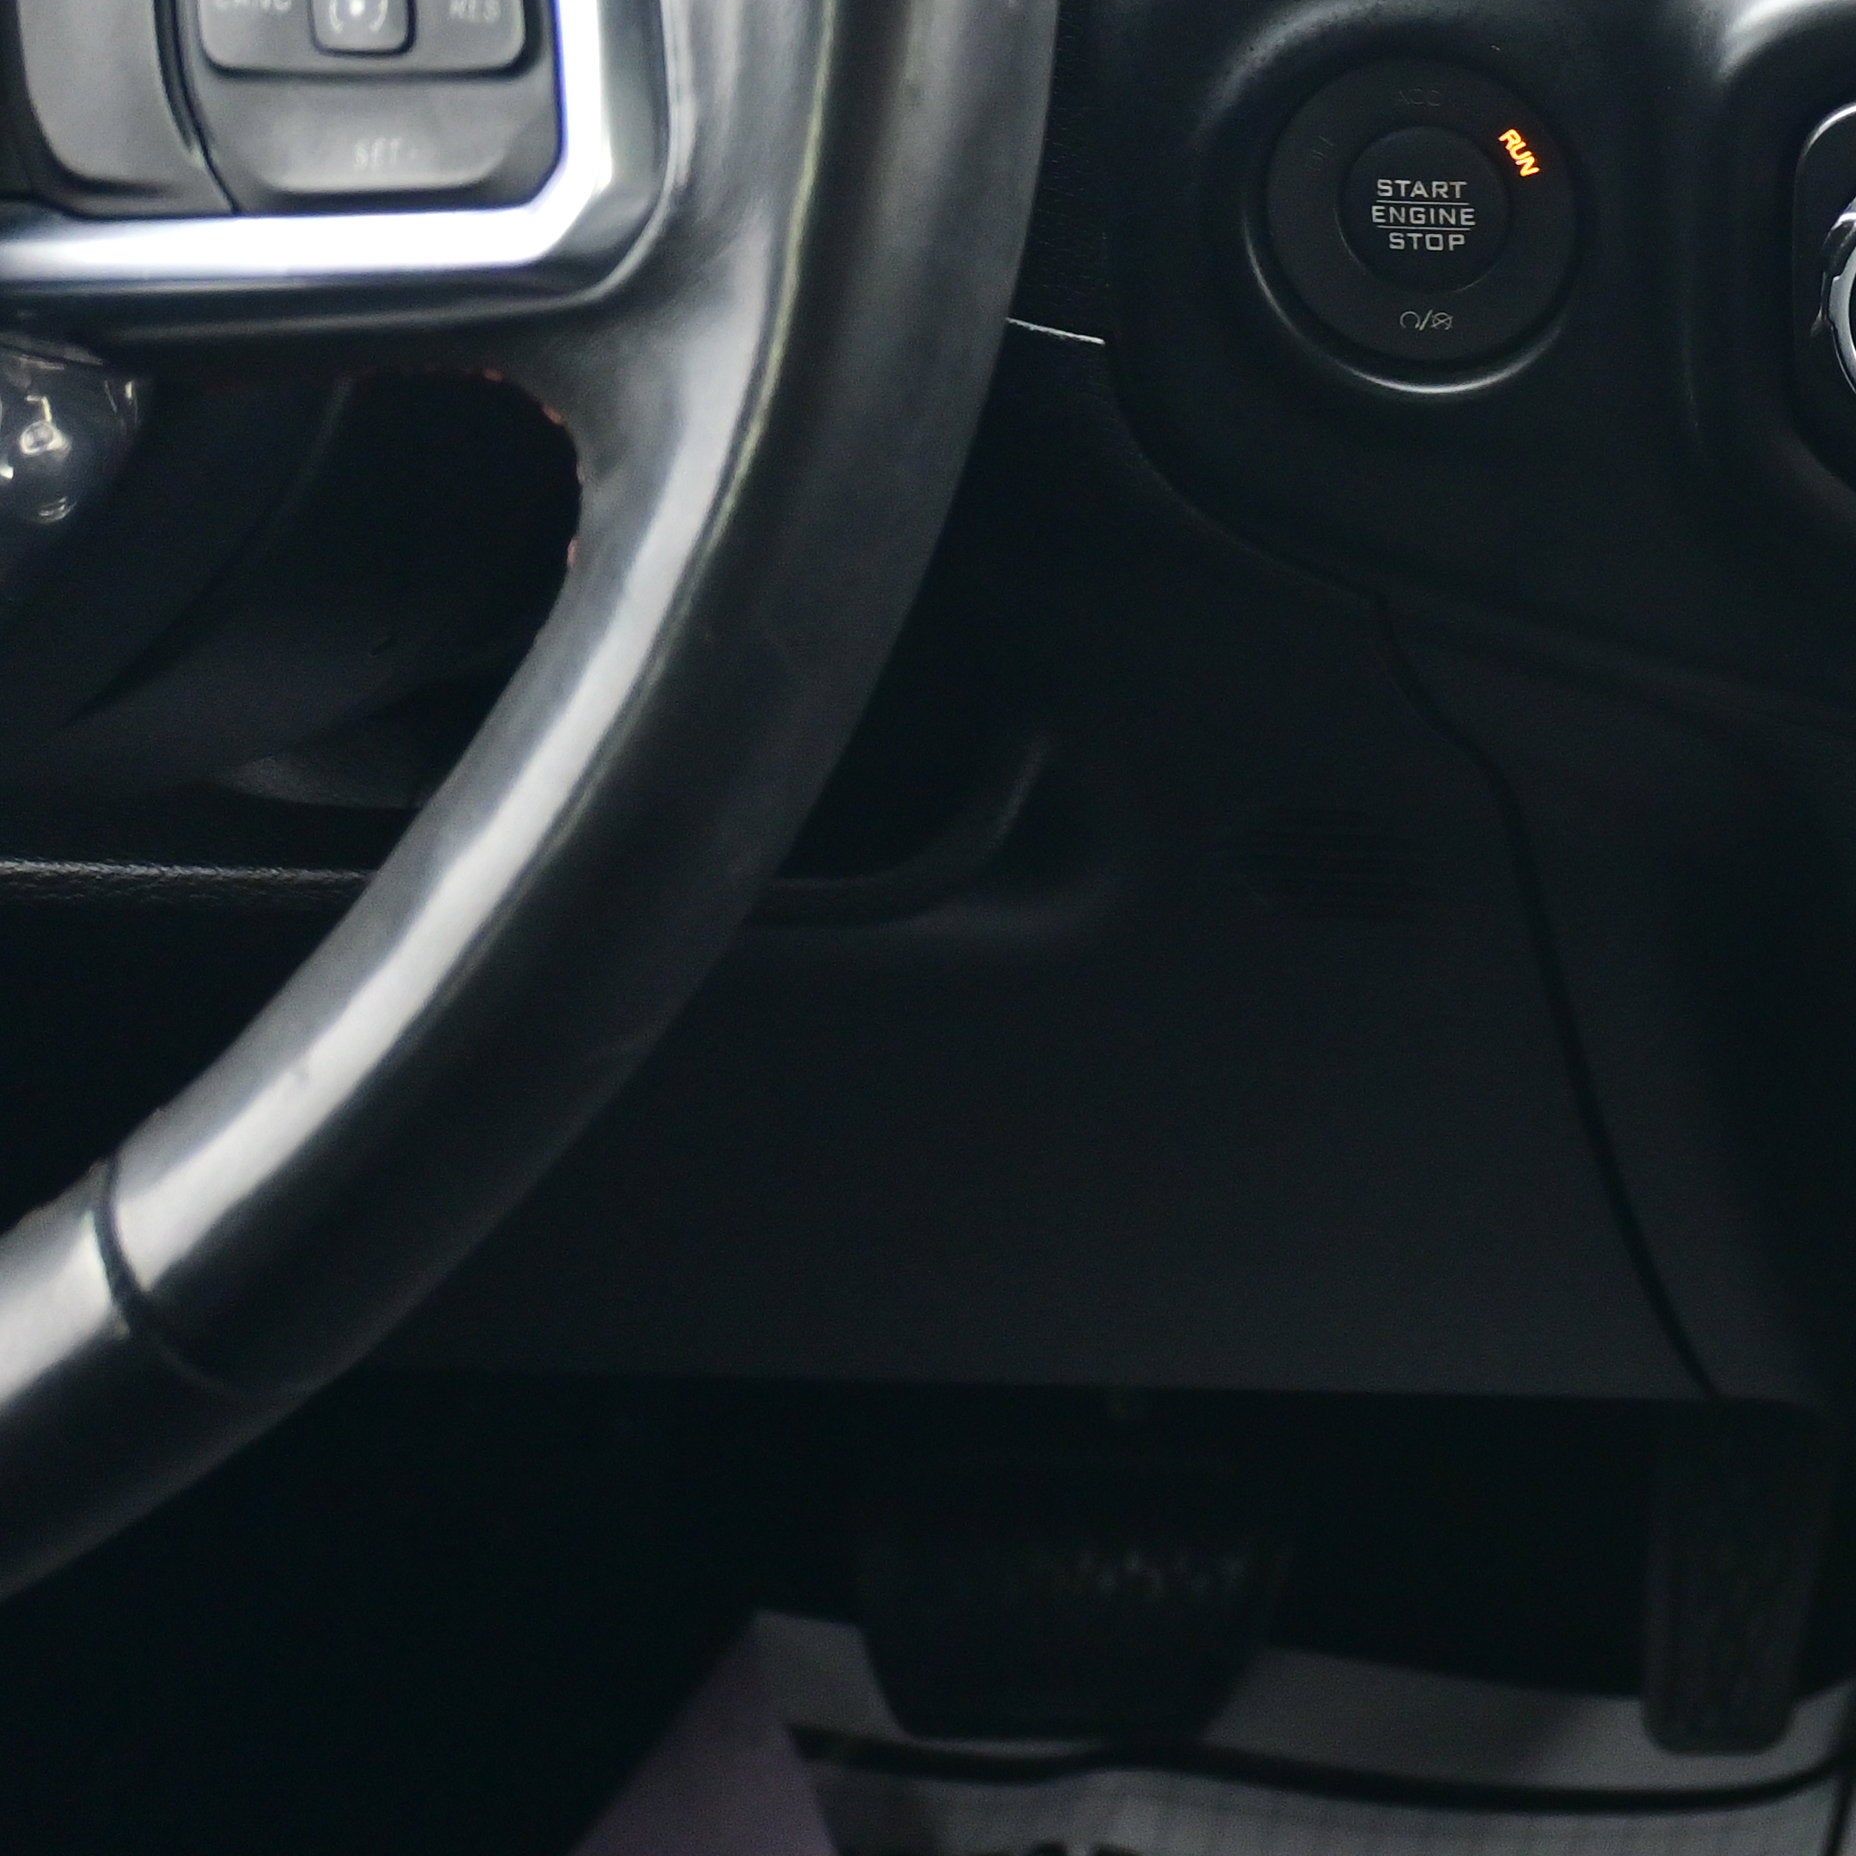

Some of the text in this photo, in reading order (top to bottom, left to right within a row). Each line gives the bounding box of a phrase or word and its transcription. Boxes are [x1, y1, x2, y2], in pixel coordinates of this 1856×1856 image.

[1498, 128, 1540, 178] RUN
[1376, 178, 1467, 200] START
[1371, 204, 1476, 227] ENGINE
[1388, 232, 1466, 251] STOP
